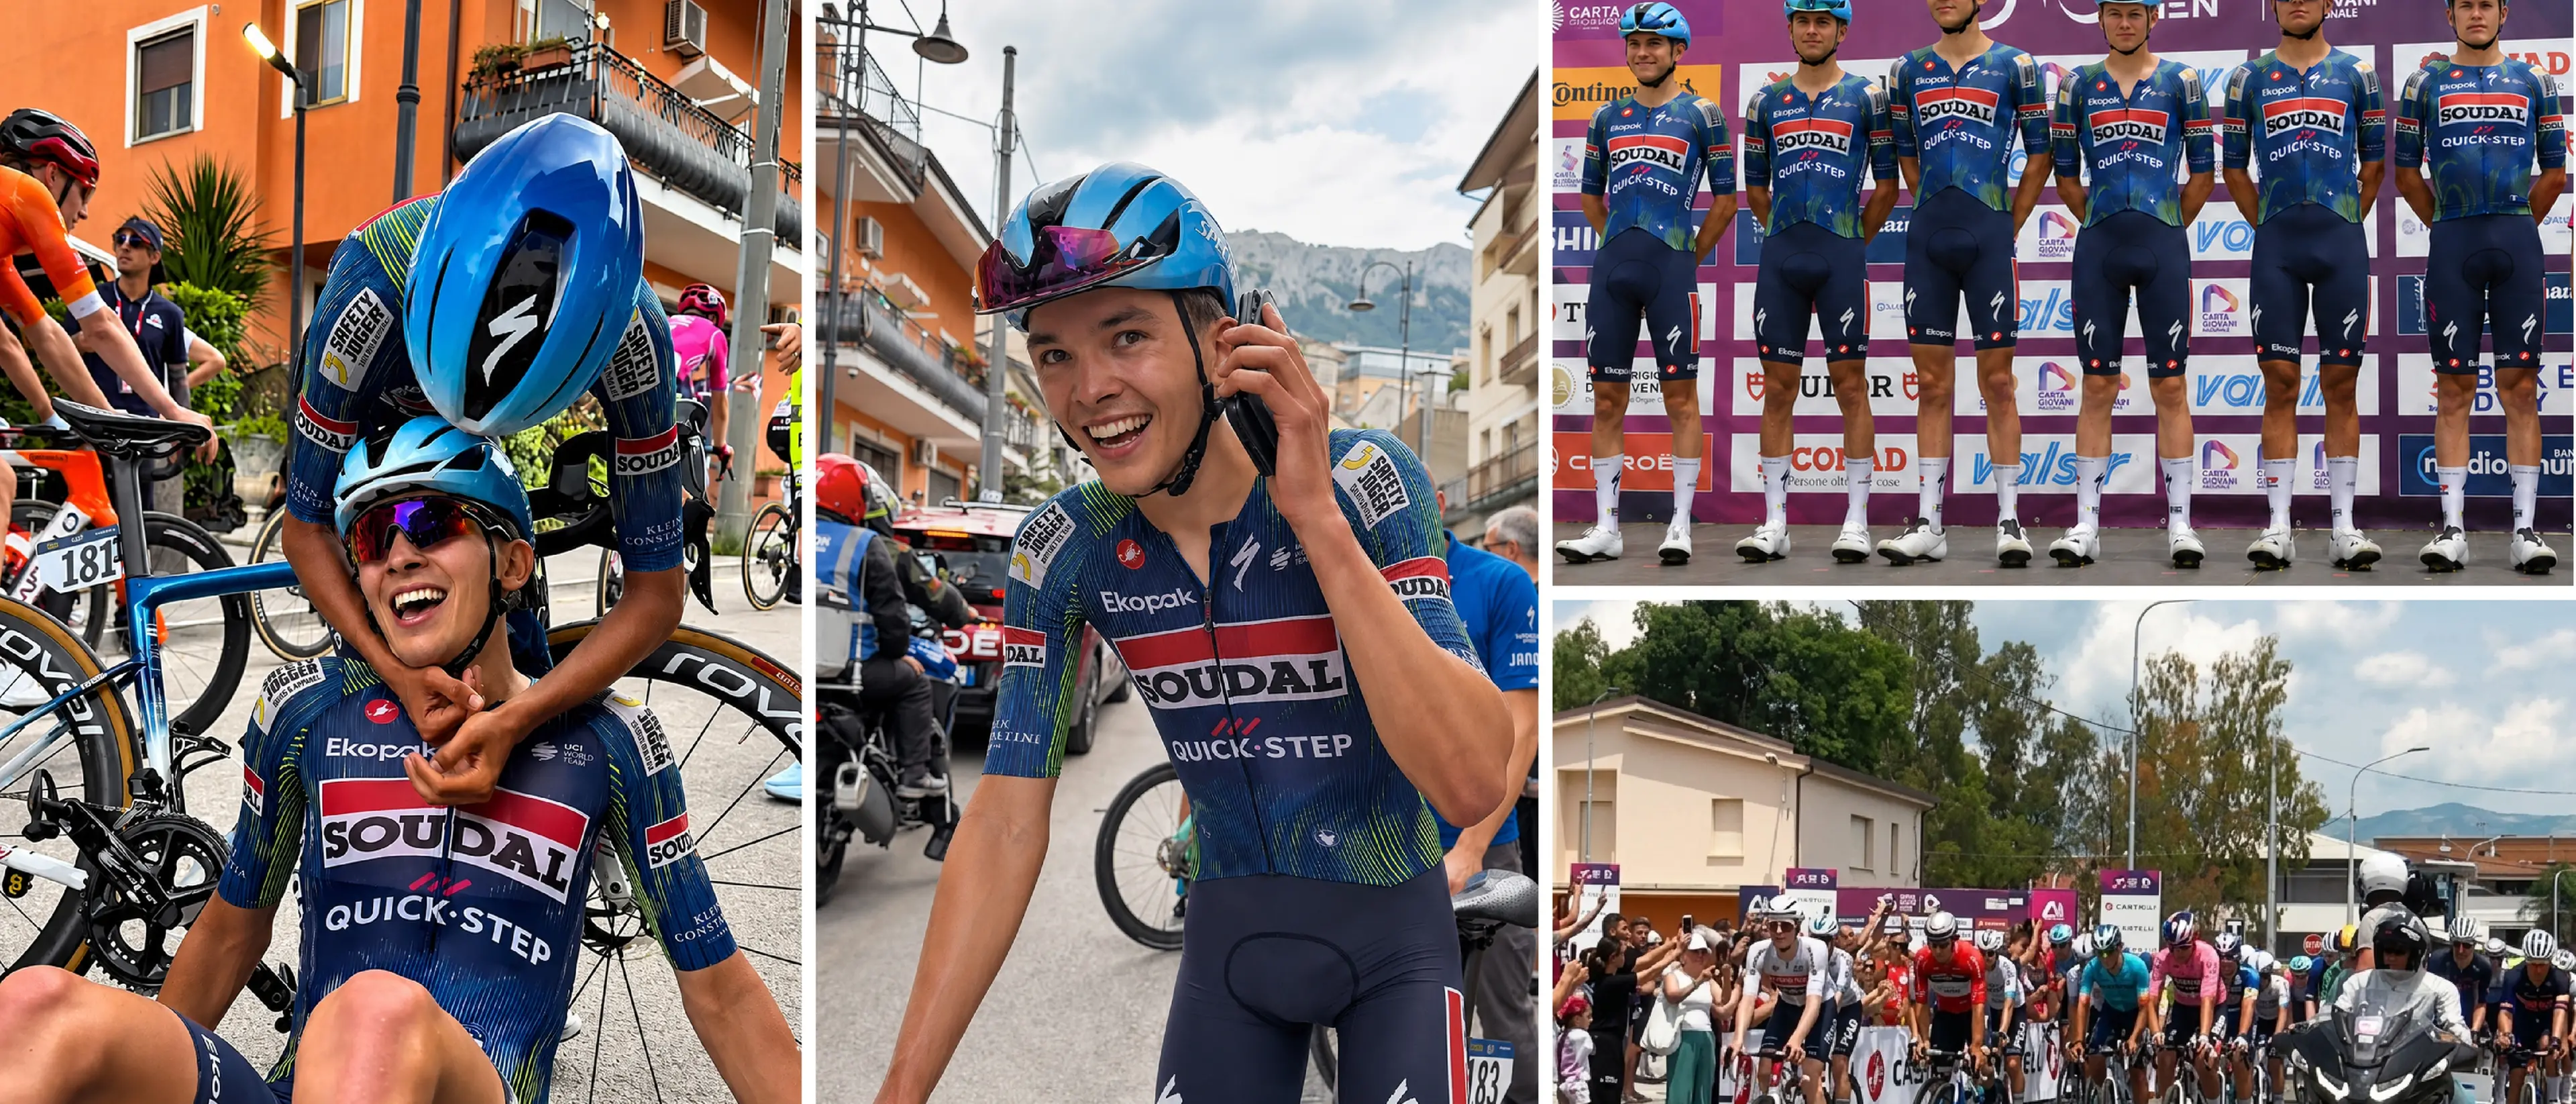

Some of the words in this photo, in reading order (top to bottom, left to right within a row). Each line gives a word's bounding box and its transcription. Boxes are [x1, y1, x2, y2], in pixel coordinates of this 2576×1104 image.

[1568, 5, 1620, 19] CARTA
[1919, 99, 1993, 123] SOUDAL
[2266, 111, 2343, 134] SOUDAL
[2440, 106, 2526, 123] SOUDAL
[1776, 132, 1847, 152] SOUDAL
[2093, 121, 2163, 143] SOUDAL
[1611, 147, 1681, 171] SOUDAL
[329, 290, 372, 353] SAFETY
[626, 323, 657, 387] SAFETY
[1369, 455, 1406, 505] SAFETY
[1788, 476, 1828, 487] Persone
[1876, 479, 1900, 487] cose
[2202, 477, 2237, 485] GIOVANI
[1018, 504, 1057, 550] SAFETY
[1028, 513, 1067, 559] JOGGER
[61, 539, 117, 589] 181
[1099, 588, 1198, 615] Ekopak
[0, 623, 105, 736] oval
[267, 663, 319, 703] JOGGER
[1134, 658, 1343, 704] SOUDAL
[563, 750, 594, 763] WORLD
[564, 743, 584, 752] UCI
[323, 813, 568, 895] SOUDAL
